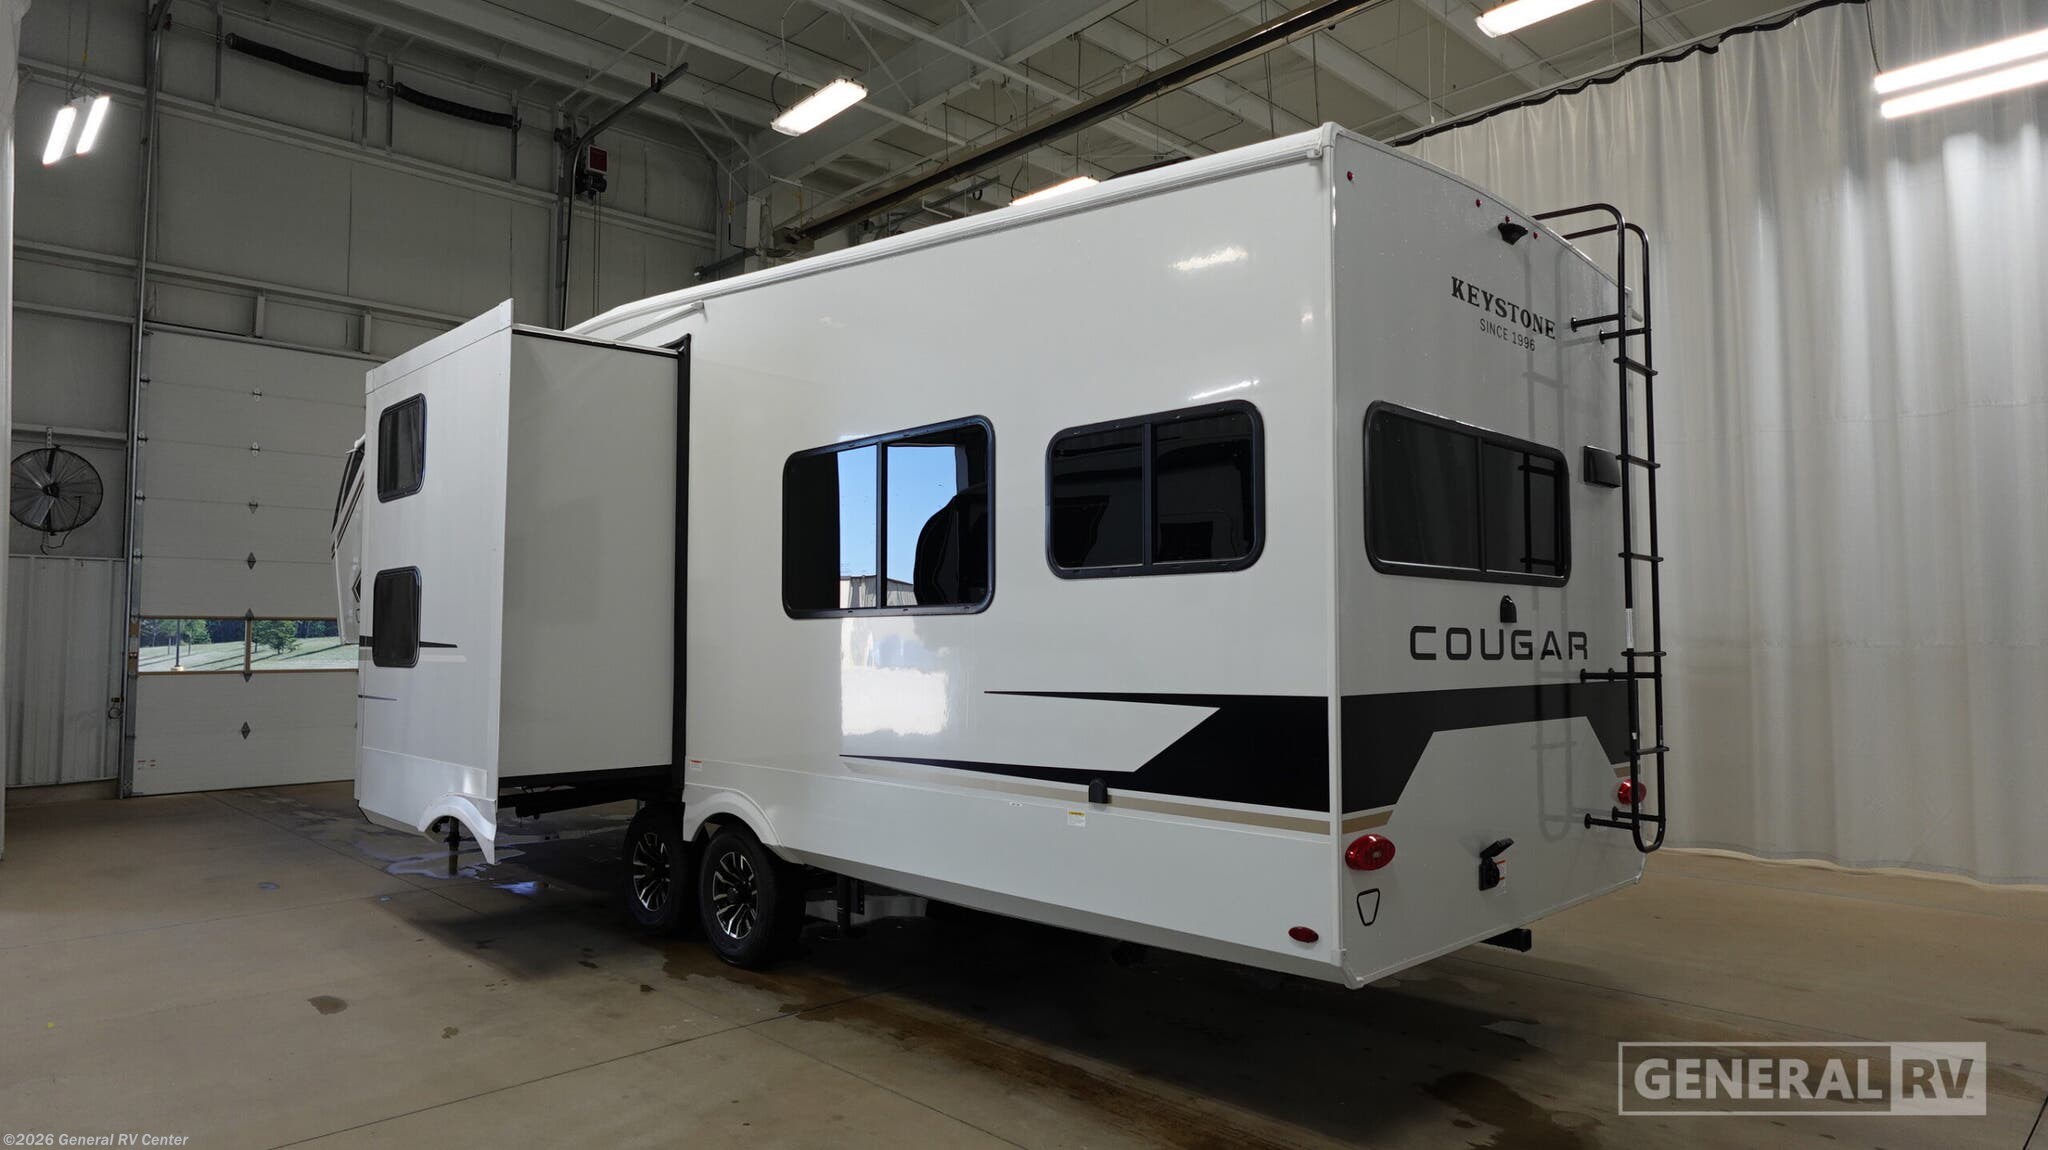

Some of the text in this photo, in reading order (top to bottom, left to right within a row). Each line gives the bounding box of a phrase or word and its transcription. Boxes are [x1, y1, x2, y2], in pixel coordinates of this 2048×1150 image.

[1451, 276, 1556, 339] KEYSTONE
[1480, 318, 1536, 351] SINCE 1996
[1410, 625, 1588, 660] COUGAR
